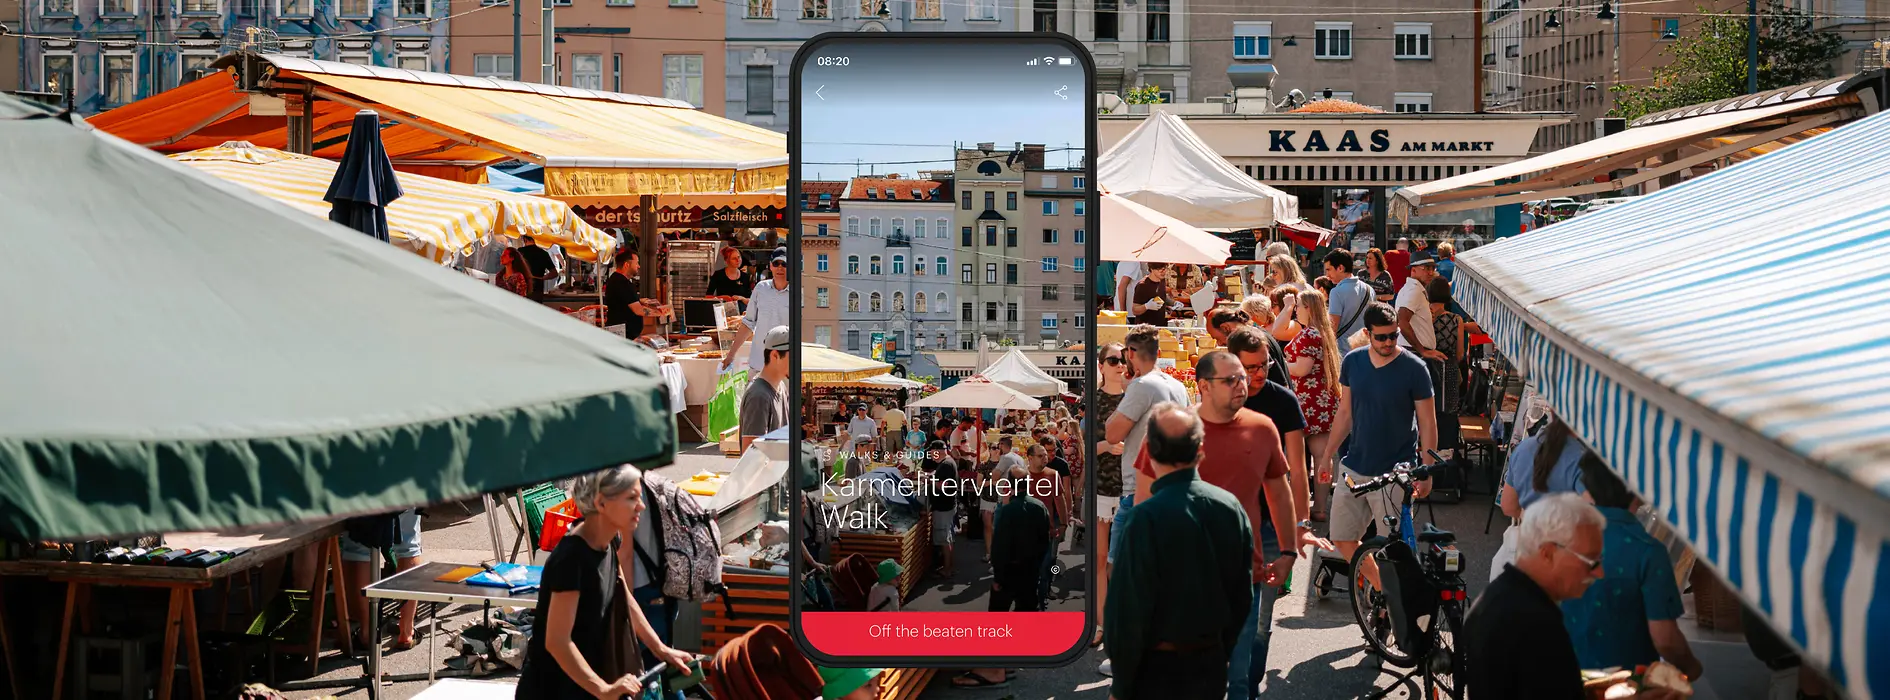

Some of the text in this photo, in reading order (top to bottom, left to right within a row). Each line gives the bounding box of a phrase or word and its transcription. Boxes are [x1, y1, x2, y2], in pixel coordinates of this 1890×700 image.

[817, 56, 850, 66] 08:20
[1268, 129, 1494, 152] KAAS AM MARKT
[595, 210, 623, 223] der
[713, 211, 768, 222] Salzfleisch
[1055, 355, 1085, 366] KA
[839, 450, 940, 460] WALKS & GUIDES
[821, 470, 1059, 497] Karmeliterviertel
[821, 503, 888, 529] Walk
[869, 624, 1013, 638] Off the beaten track
